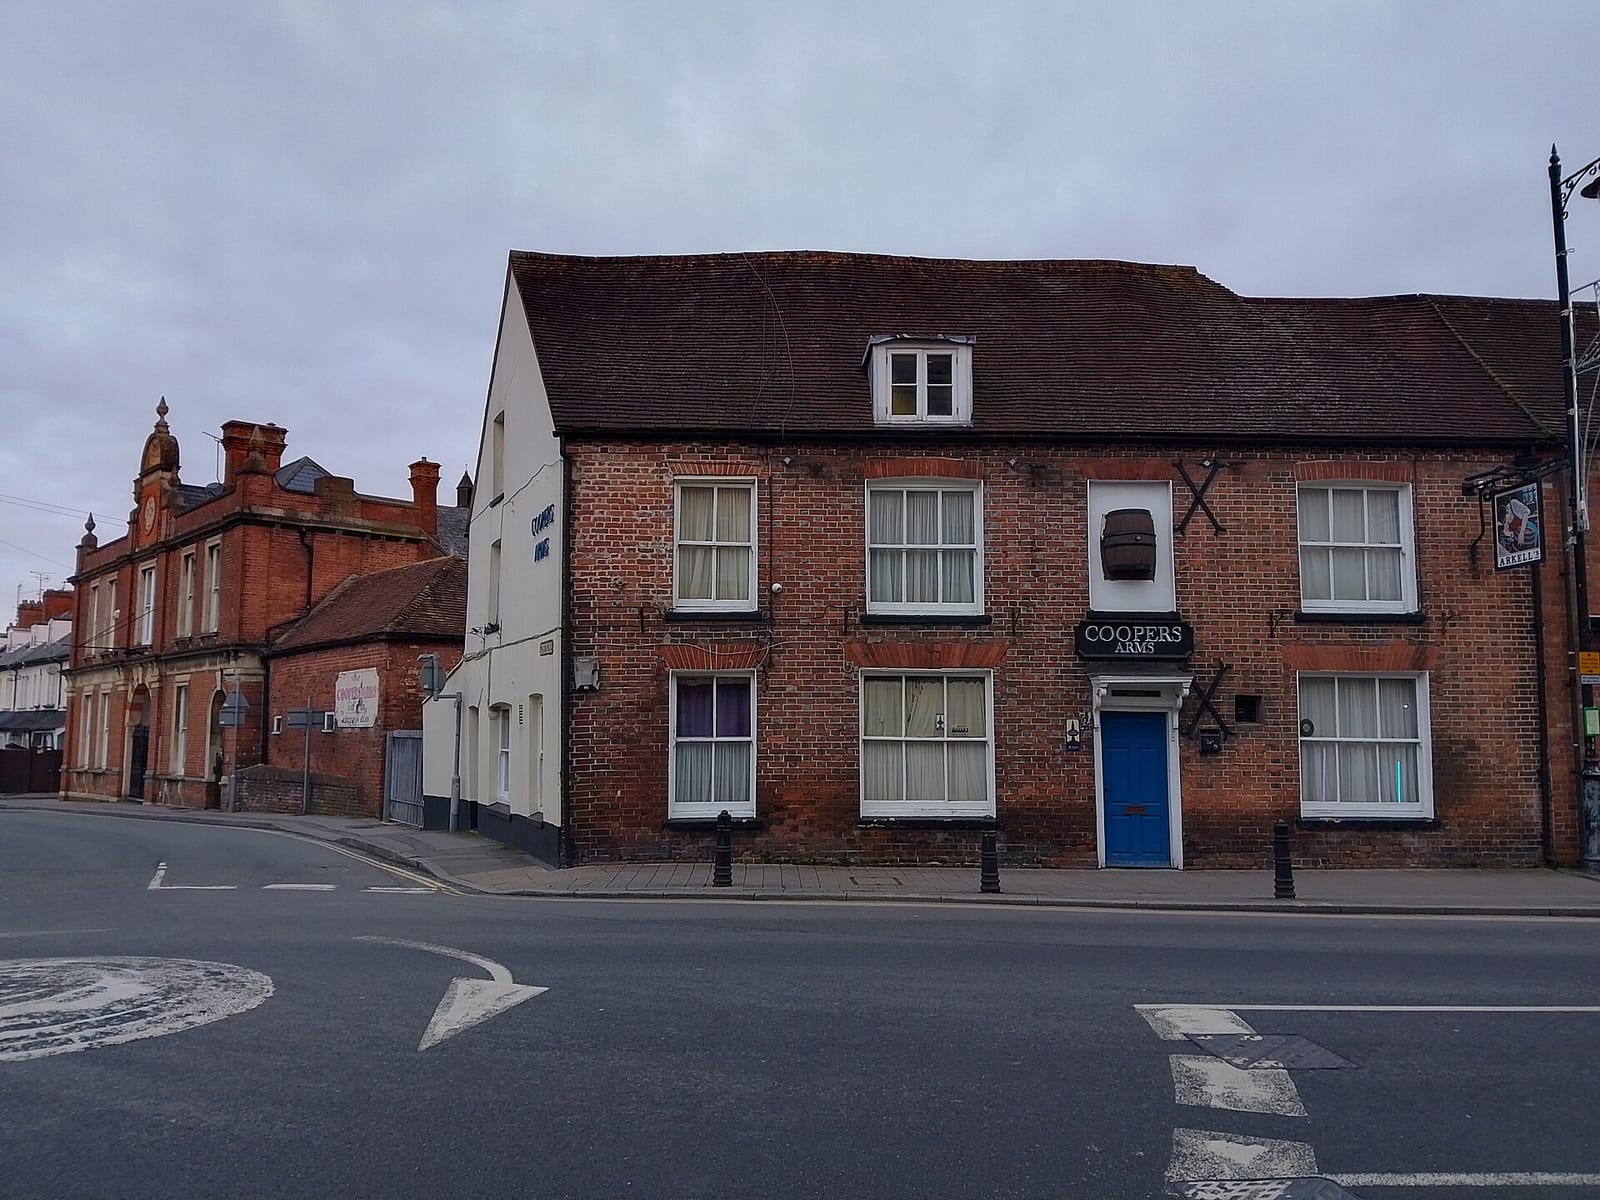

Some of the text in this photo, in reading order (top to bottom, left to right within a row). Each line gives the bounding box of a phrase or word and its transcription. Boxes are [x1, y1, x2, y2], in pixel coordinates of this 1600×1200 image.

[1499, 550, 1540, 567] ARKELL'S
[1085, 625, 1182, 642] COOPERS
[1114, 642, 1155, 653] ARMS
